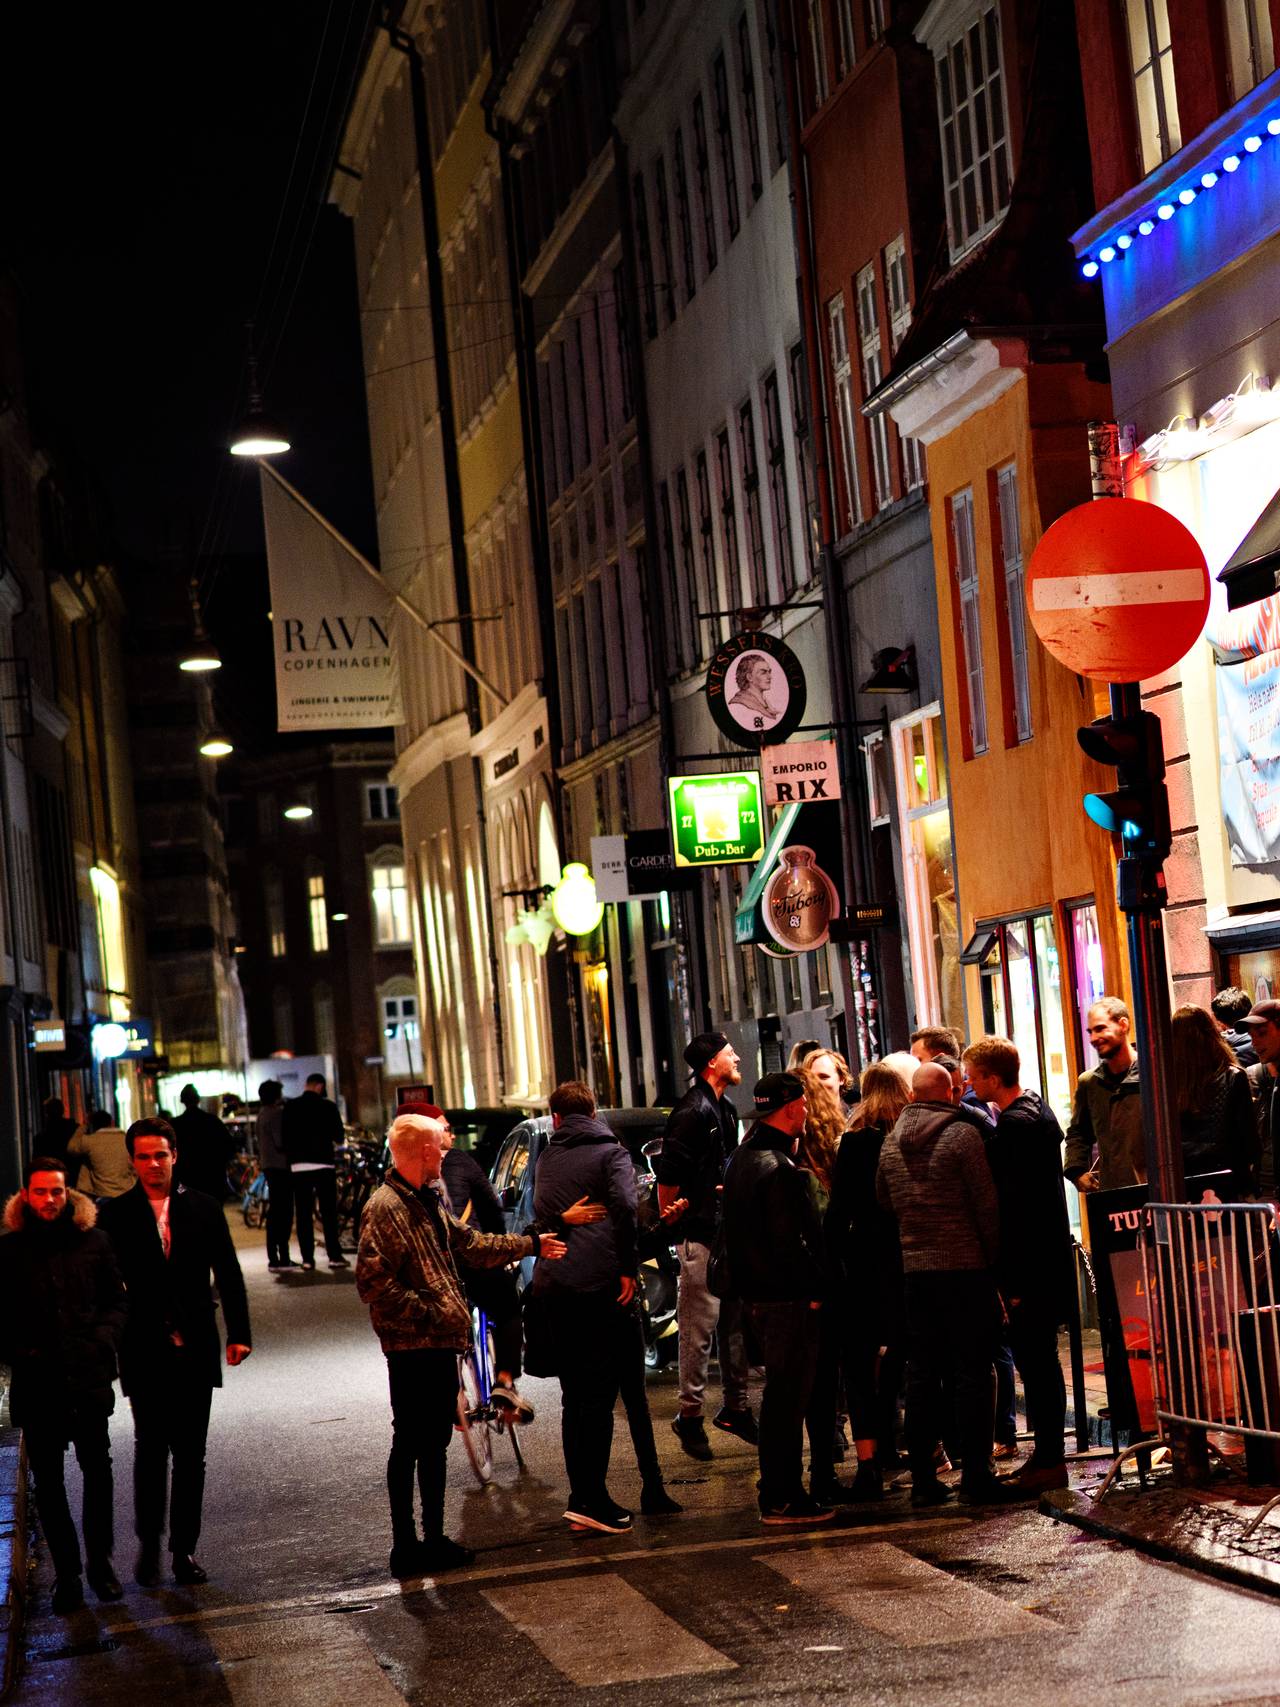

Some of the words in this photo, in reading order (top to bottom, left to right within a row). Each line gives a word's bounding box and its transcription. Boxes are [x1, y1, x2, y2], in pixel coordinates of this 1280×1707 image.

[282, 616, 390, 653] RAVN
[283, 656, 391, 671] COPENHAGEN
[709, 634, 773, 697] WESSELS
[291, 696, 329, 706] LINGERIE
[772, 761, 828, 775] EMPORIO
[775, 778, 829, 802] RIX
[681, 815, 693, 829] 17
[741, 811, 756, 824] 72
[694, 843, 720, 857] Pub
[726, 843, 746, 855] Bar
[774, 888, 827, 917] Tuborg
